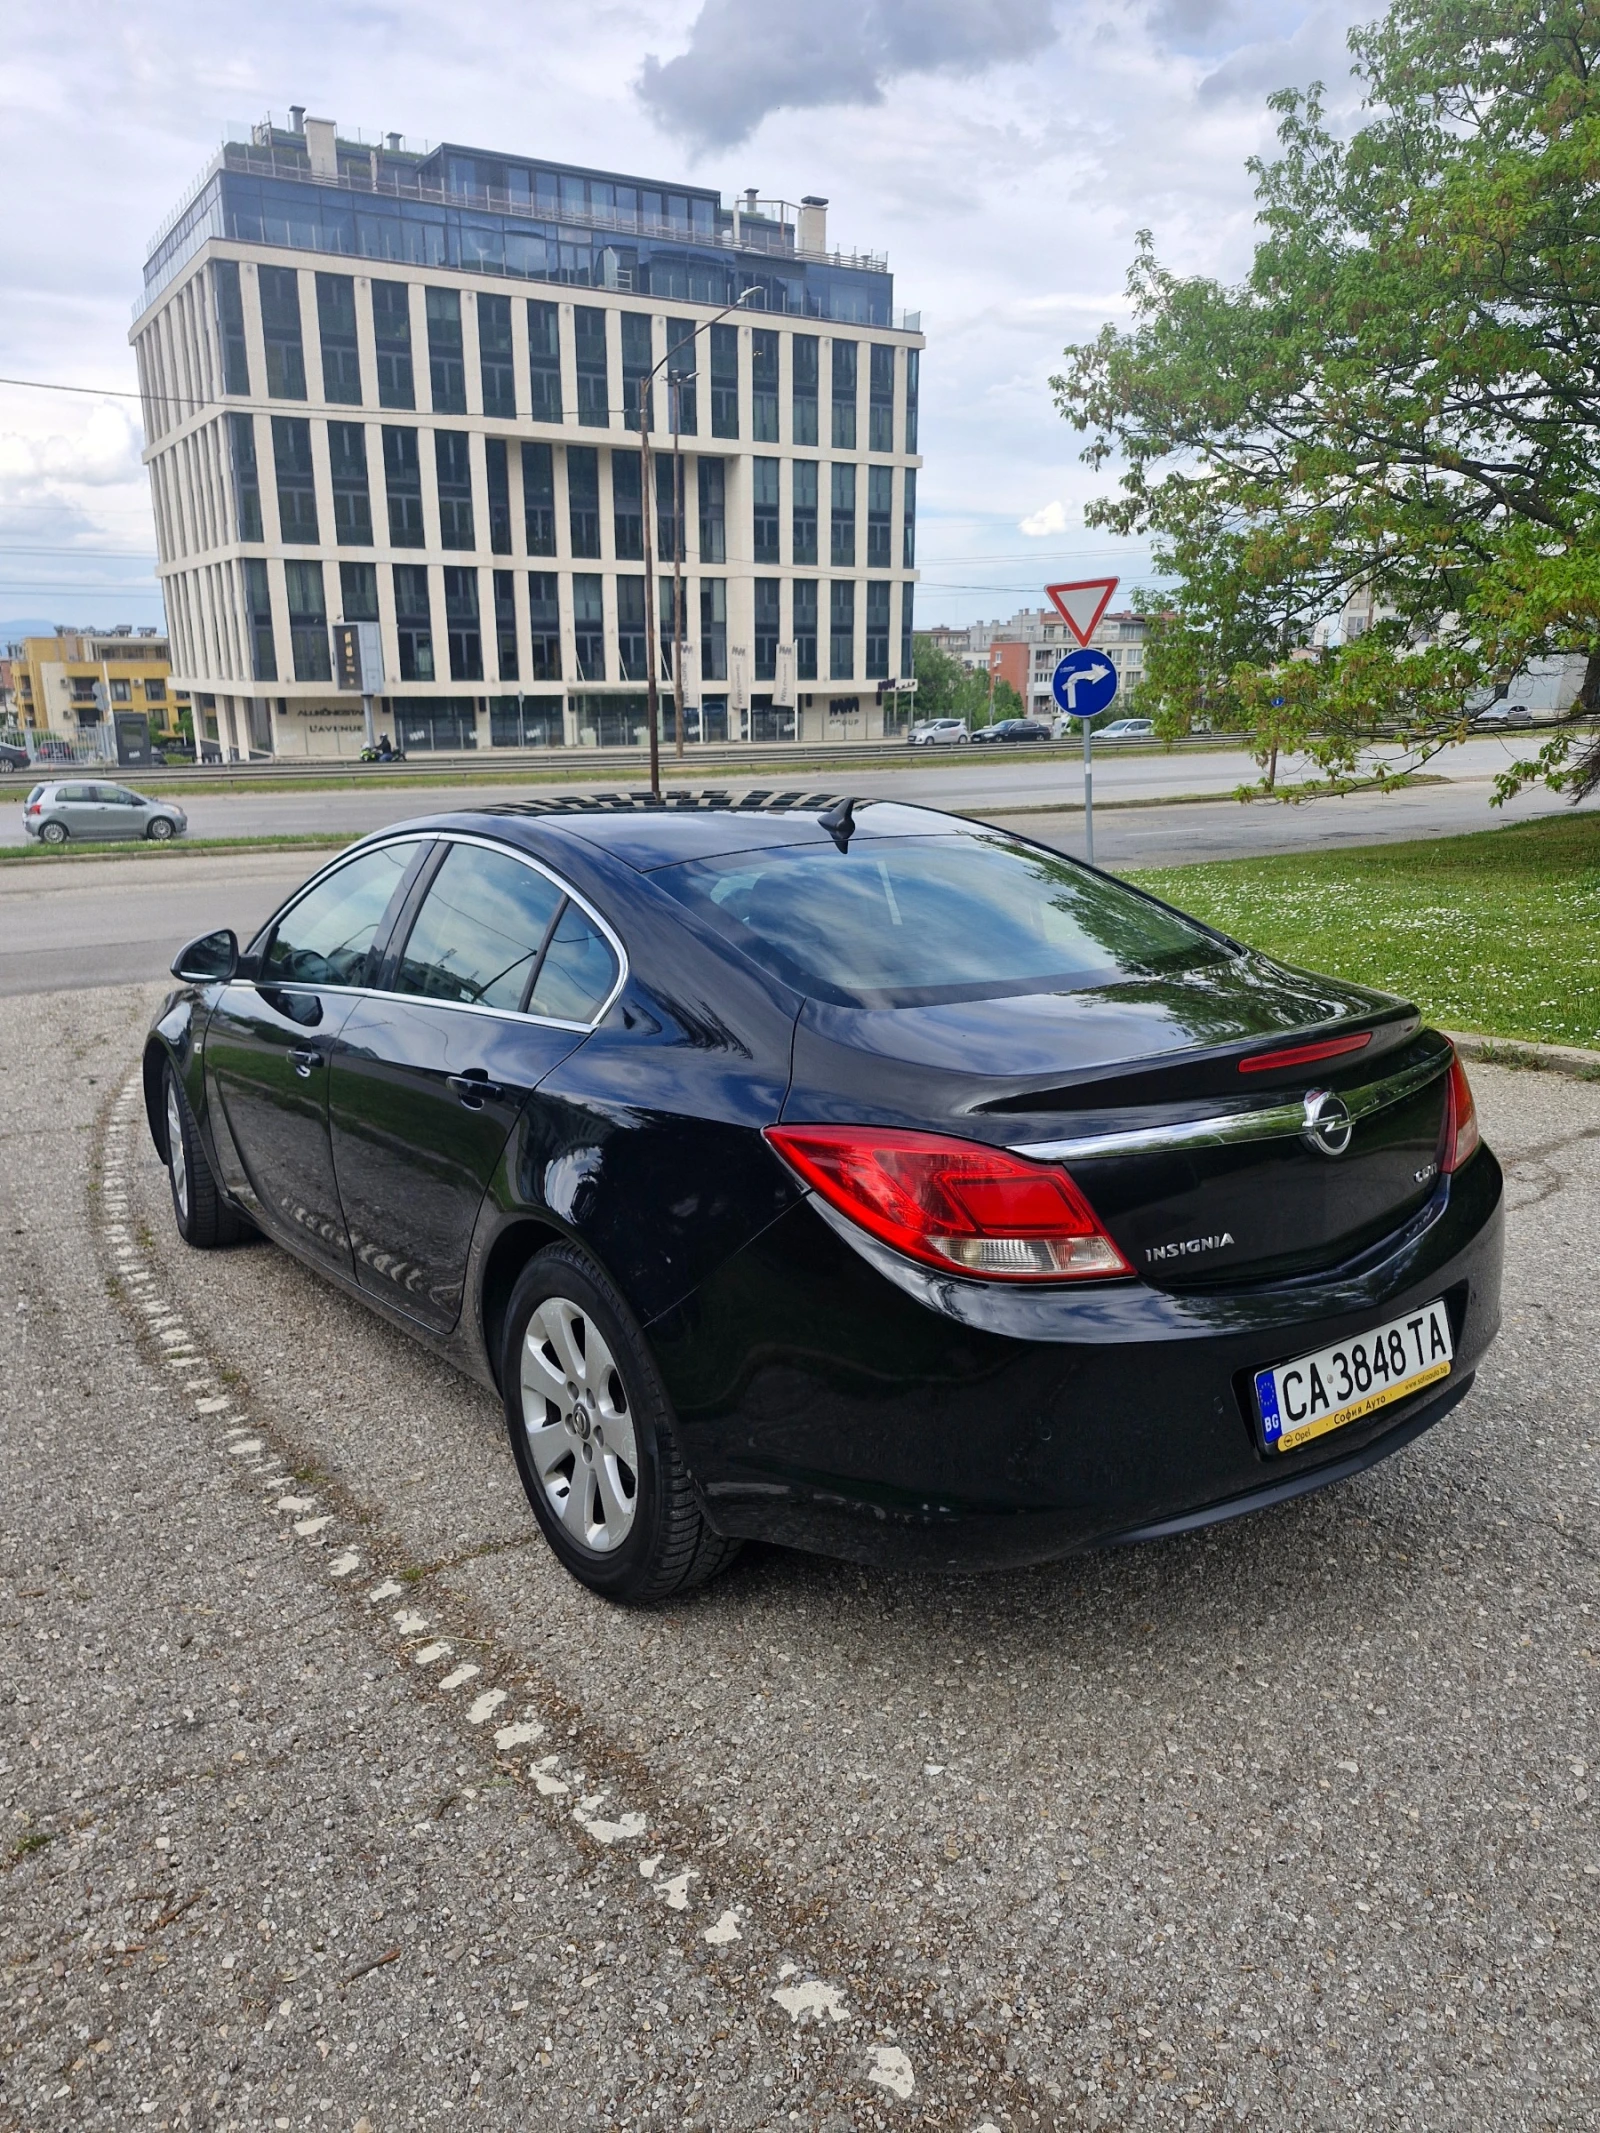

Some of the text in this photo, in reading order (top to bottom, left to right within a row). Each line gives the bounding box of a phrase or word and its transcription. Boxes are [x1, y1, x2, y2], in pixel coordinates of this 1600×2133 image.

[1145, 1232, 1235, 1262] INSIGNIA
[1282, 1312, 1447, 1422] CA 3848 TA
[1264, 1413, 1280, 1433] BG
[1333, 1395, 1386, 1425] София Ауто
[1294, 1428, 1311, 1442] Opel
